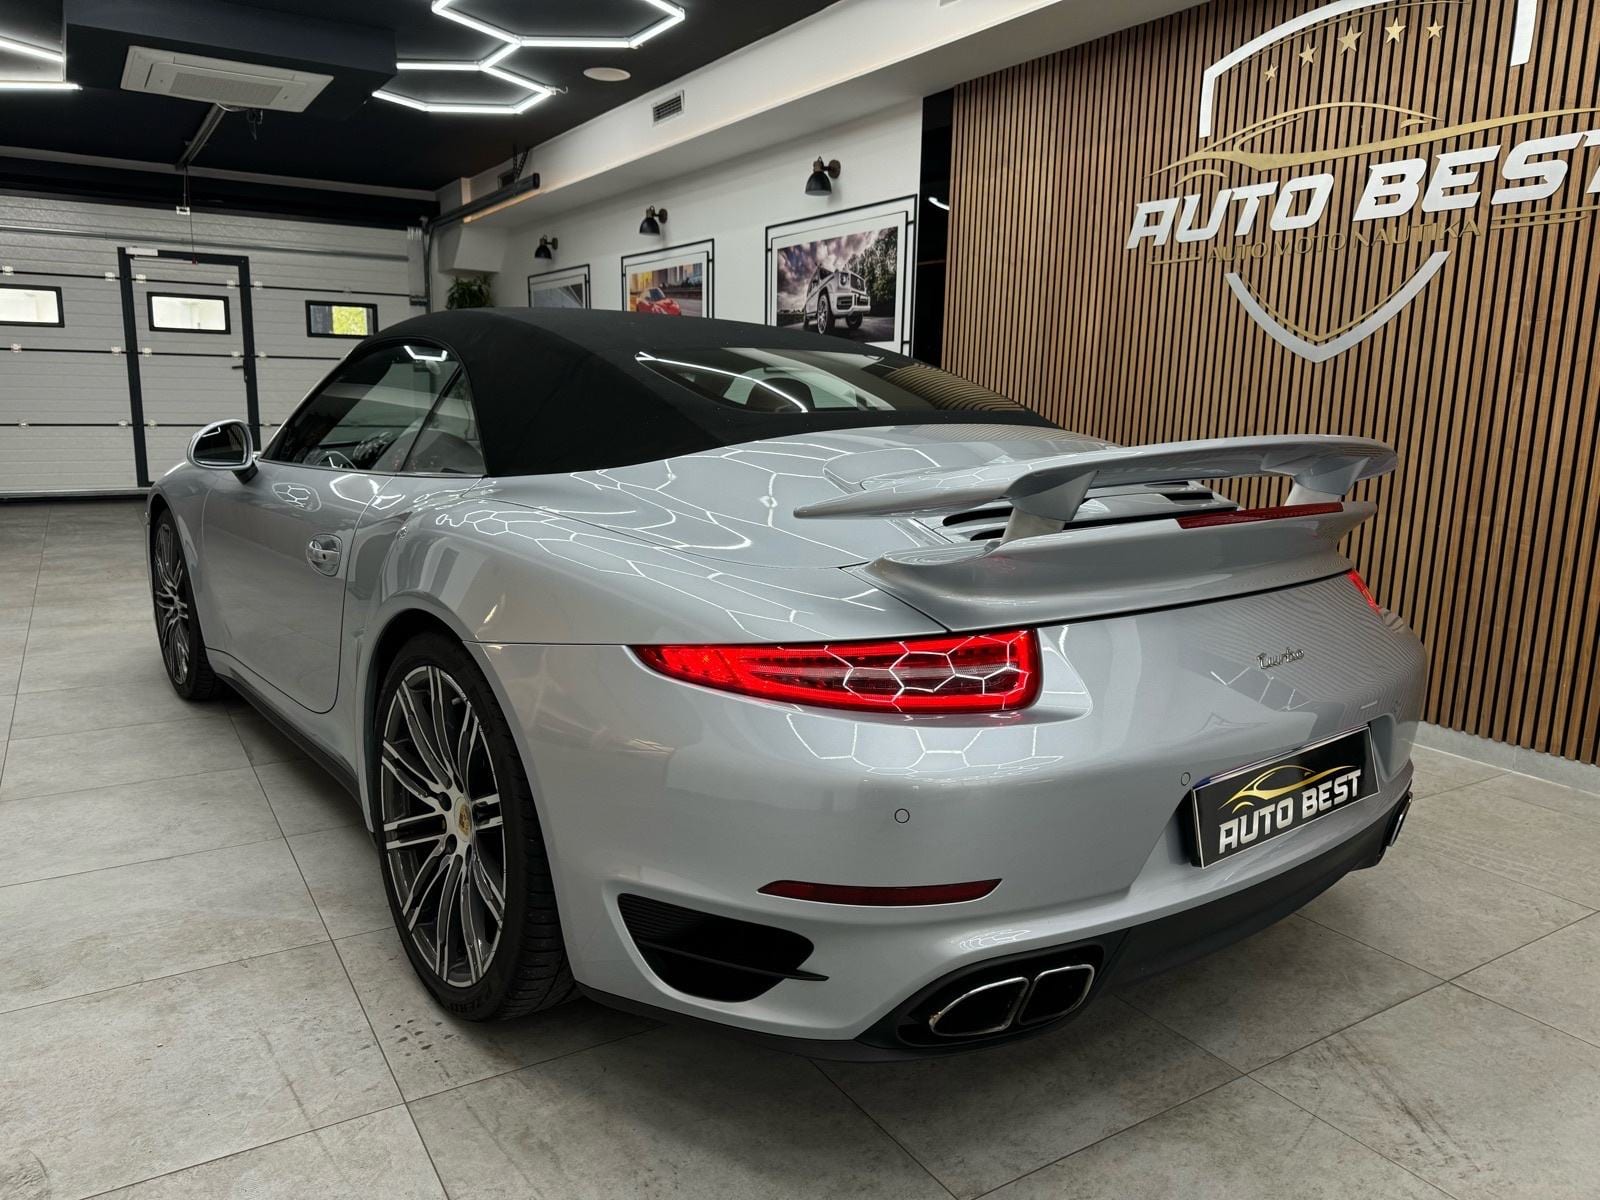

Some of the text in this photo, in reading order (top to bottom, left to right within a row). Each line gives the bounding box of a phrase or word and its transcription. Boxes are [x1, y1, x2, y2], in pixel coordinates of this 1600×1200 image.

[1126, 129, 1600, 249] AUTO BES
[1207, 218, 1481, 264] AUTO MOTO NAUTIKA
[1218, 769, 1361, 854] AUTO BEST
